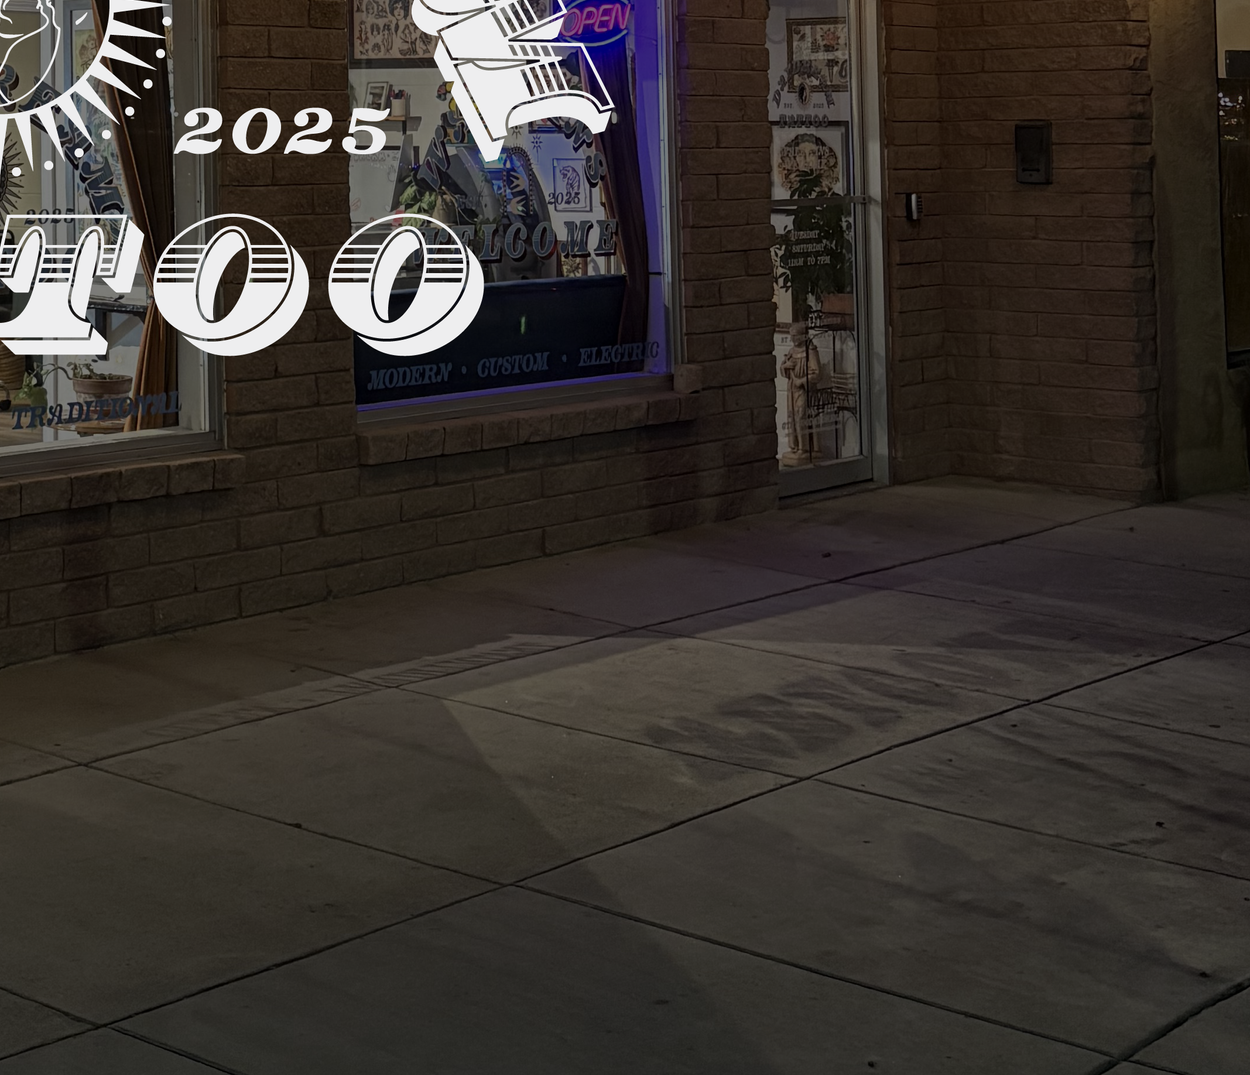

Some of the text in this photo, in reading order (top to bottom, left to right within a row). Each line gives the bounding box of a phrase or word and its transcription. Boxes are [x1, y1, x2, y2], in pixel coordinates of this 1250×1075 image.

[560, 3, 631, 36] OPEN
[548, 191, 581, 206] 2025
[24, 208, 76, 225] 2025
[412, 218, 618, 265] WELCOME
[807, 256, 816, 266] TO
[367, 341, 659, 391] MODERN CUSTOM ELECTRIC
[11, 391, 182, 430] TRADITIONAL
